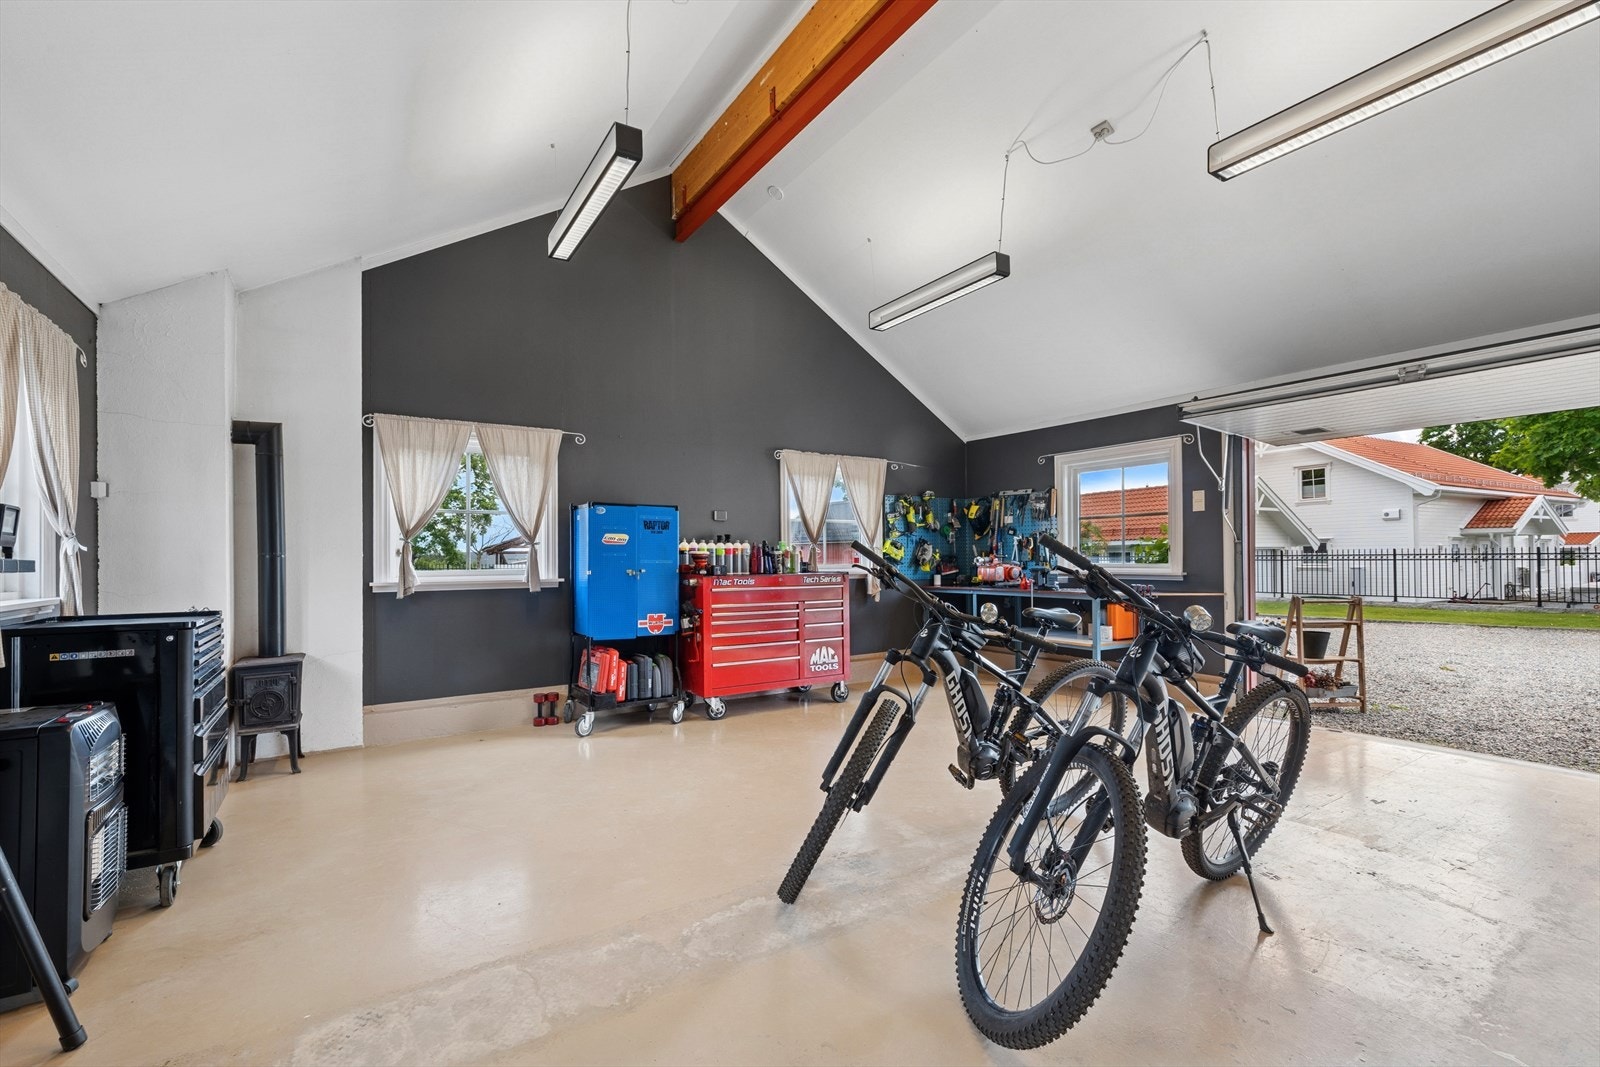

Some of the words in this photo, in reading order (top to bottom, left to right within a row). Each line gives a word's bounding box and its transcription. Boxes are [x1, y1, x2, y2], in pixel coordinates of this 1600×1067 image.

[713, 578, 731, 586] Mac
[733, 577, 755, 585] Tools
[803, 575, 818, 583] Tech
[820, 575, 841, 583] Series
[810, 645, 839, 665] MAC
[810, 663, 839, 672] TOOLS
[945, 670, 973, 742] GHOST
